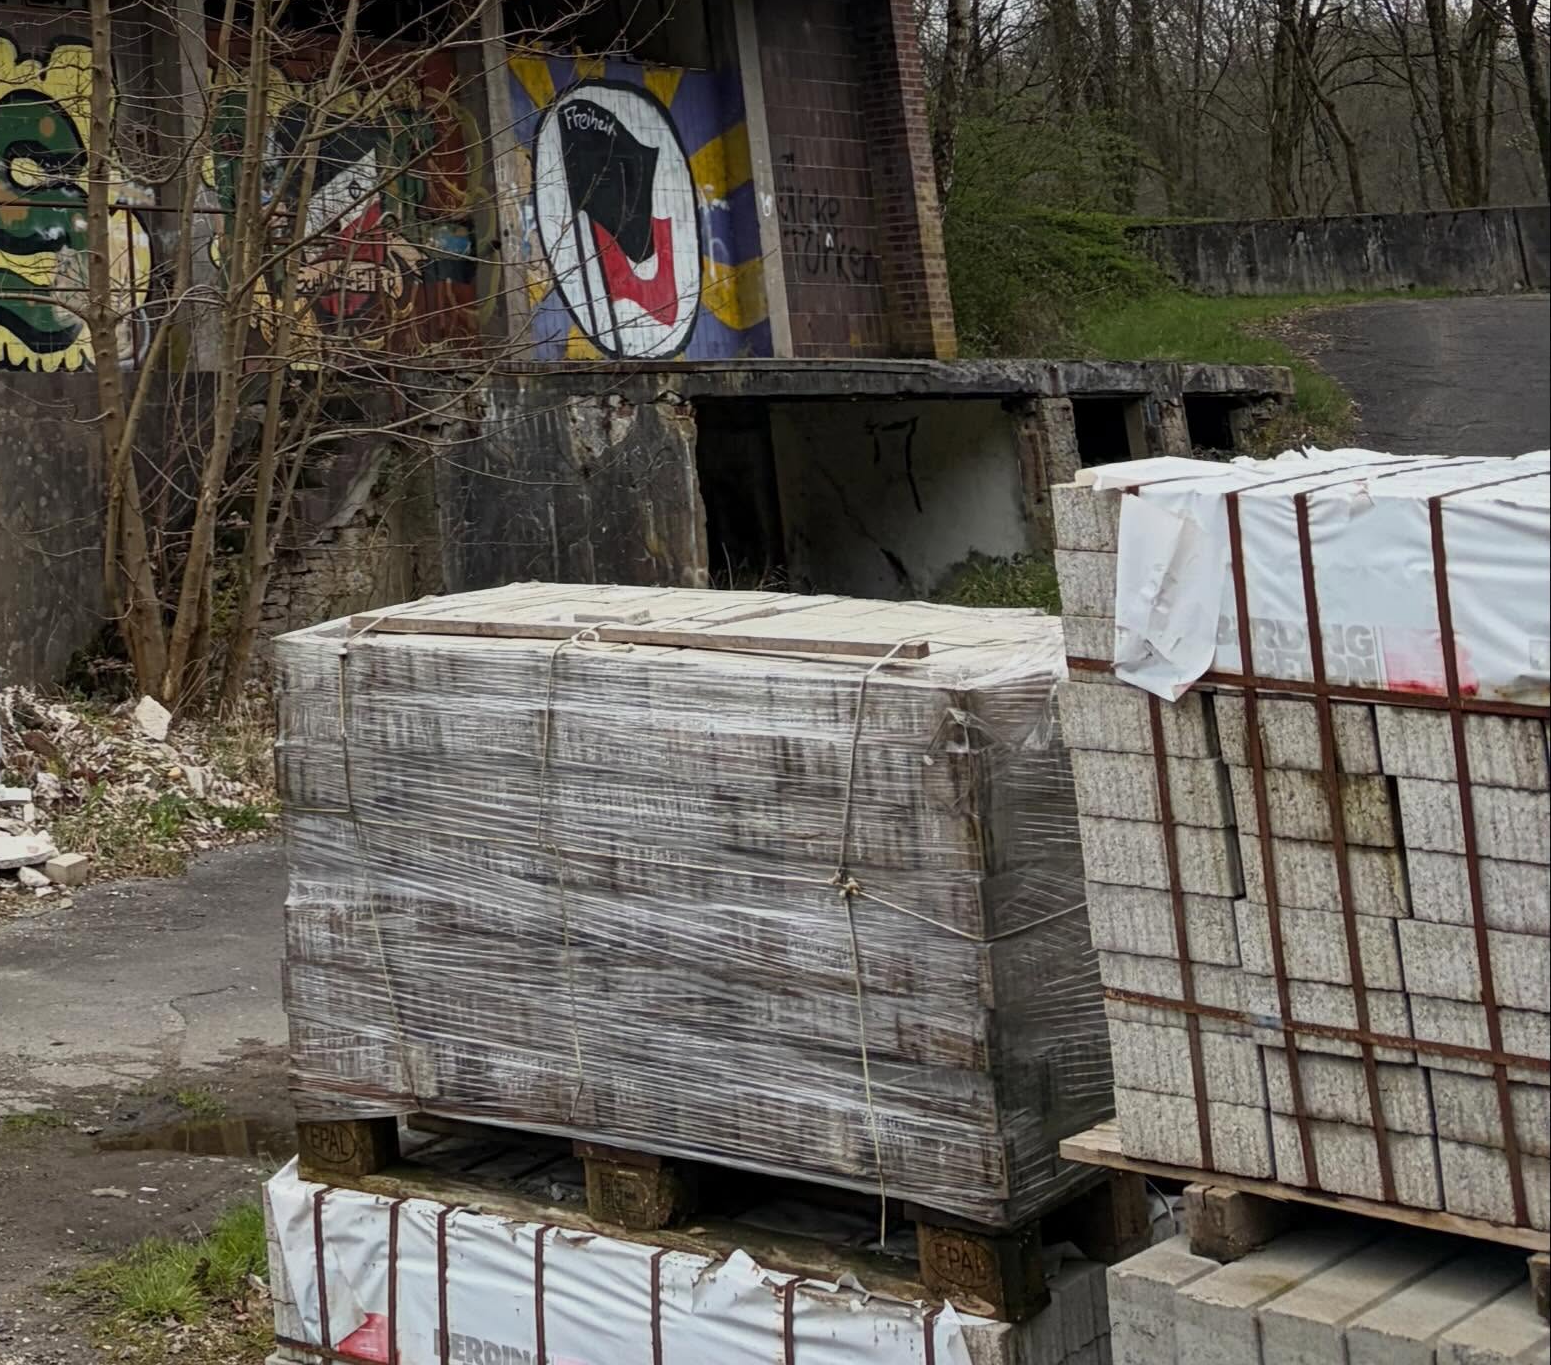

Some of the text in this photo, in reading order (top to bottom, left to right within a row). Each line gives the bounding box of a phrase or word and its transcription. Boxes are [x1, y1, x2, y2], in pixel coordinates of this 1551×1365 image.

[1216, 614, 1375, 658] BRDNG
[306, 1126, 348, 1156] EPAL
[935, 1242, 988, 1280] EPAL
